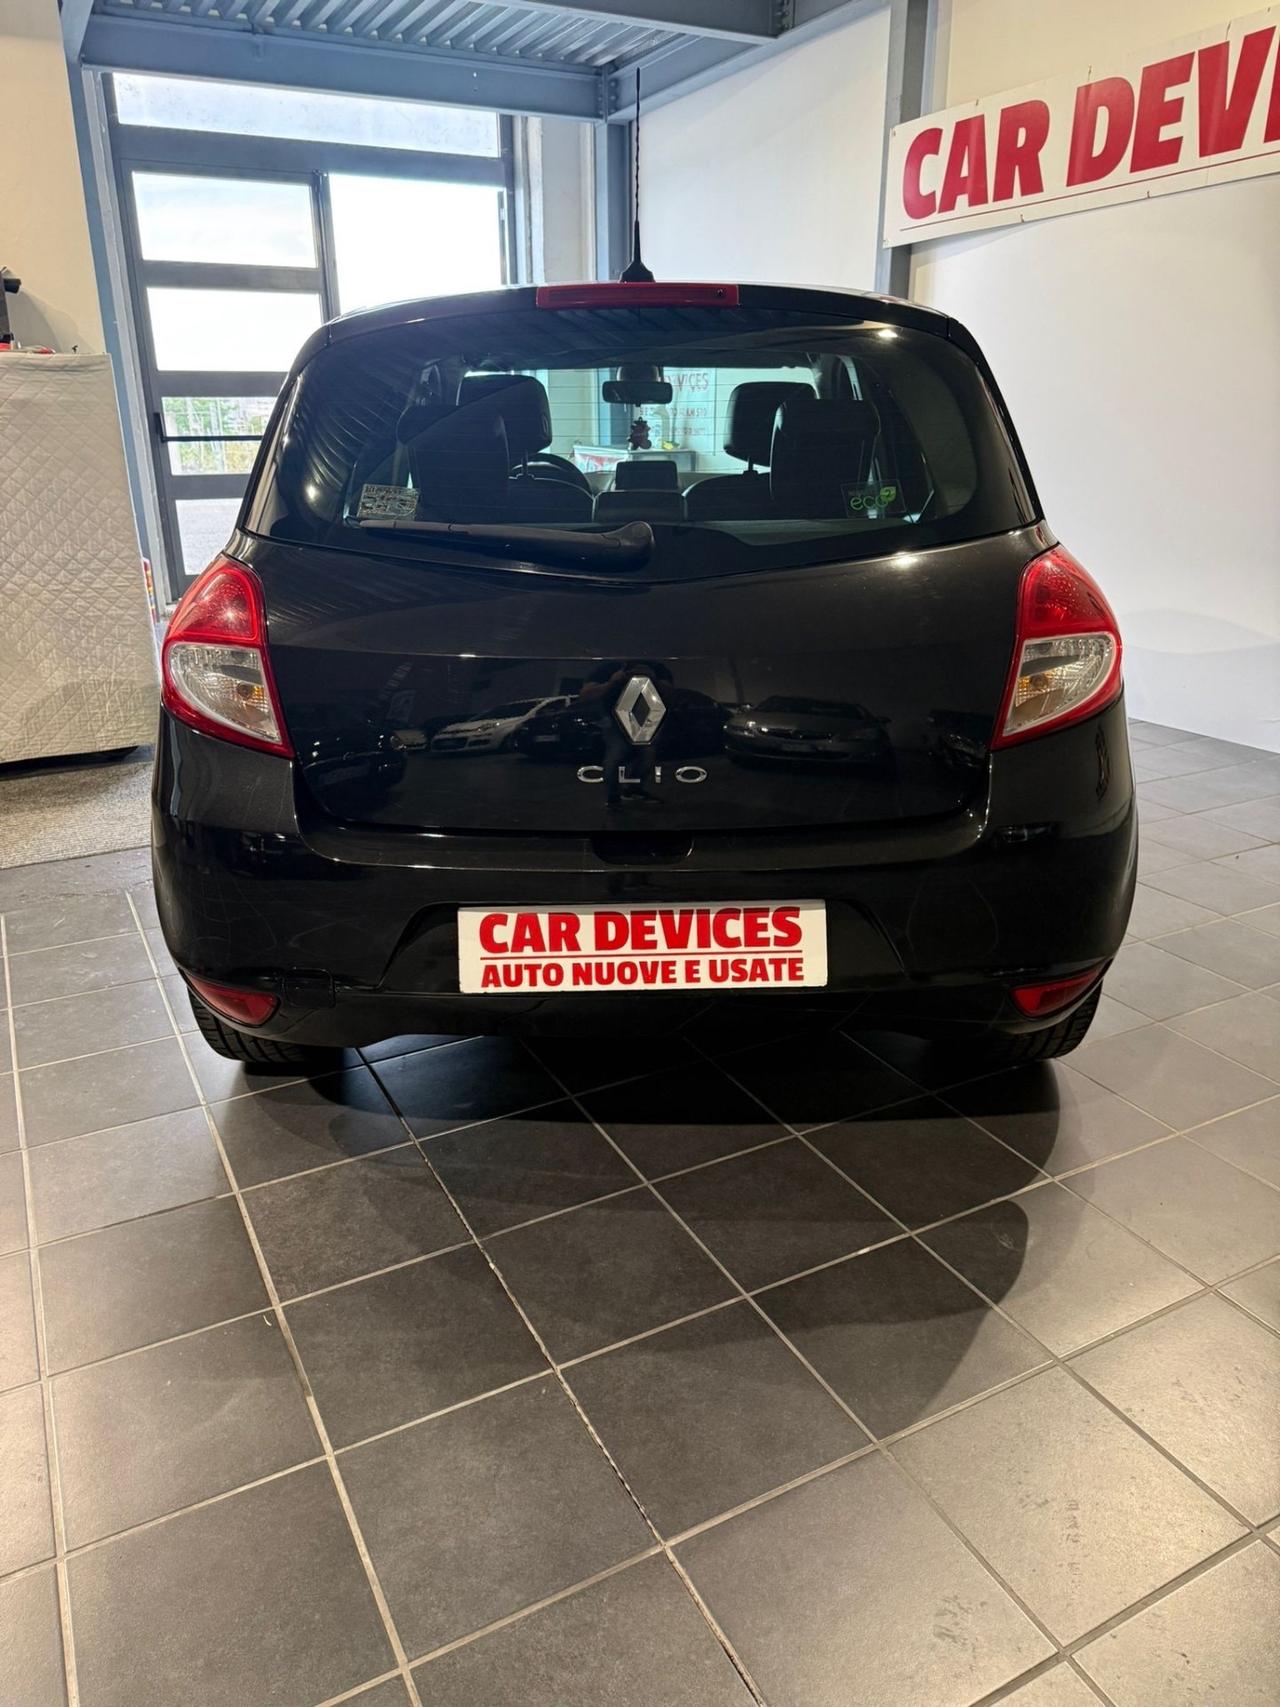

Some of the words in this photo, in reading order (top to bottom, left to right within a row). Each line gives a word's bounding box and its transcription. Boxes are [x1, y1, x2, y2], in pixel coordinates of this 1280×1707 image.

[903, 100, 1050, 220] CAR
[577, 765, 708, 783] CLIO
[479, 911, 581, 954] CAR
[593, 906, 801, 951] DEVICES
[480, 962, 564, 988] AUTO
[571, 959, 677, 987] NUOVE
[684, 959, 701, 984] E
[708, 957, 805, 983] USATE
